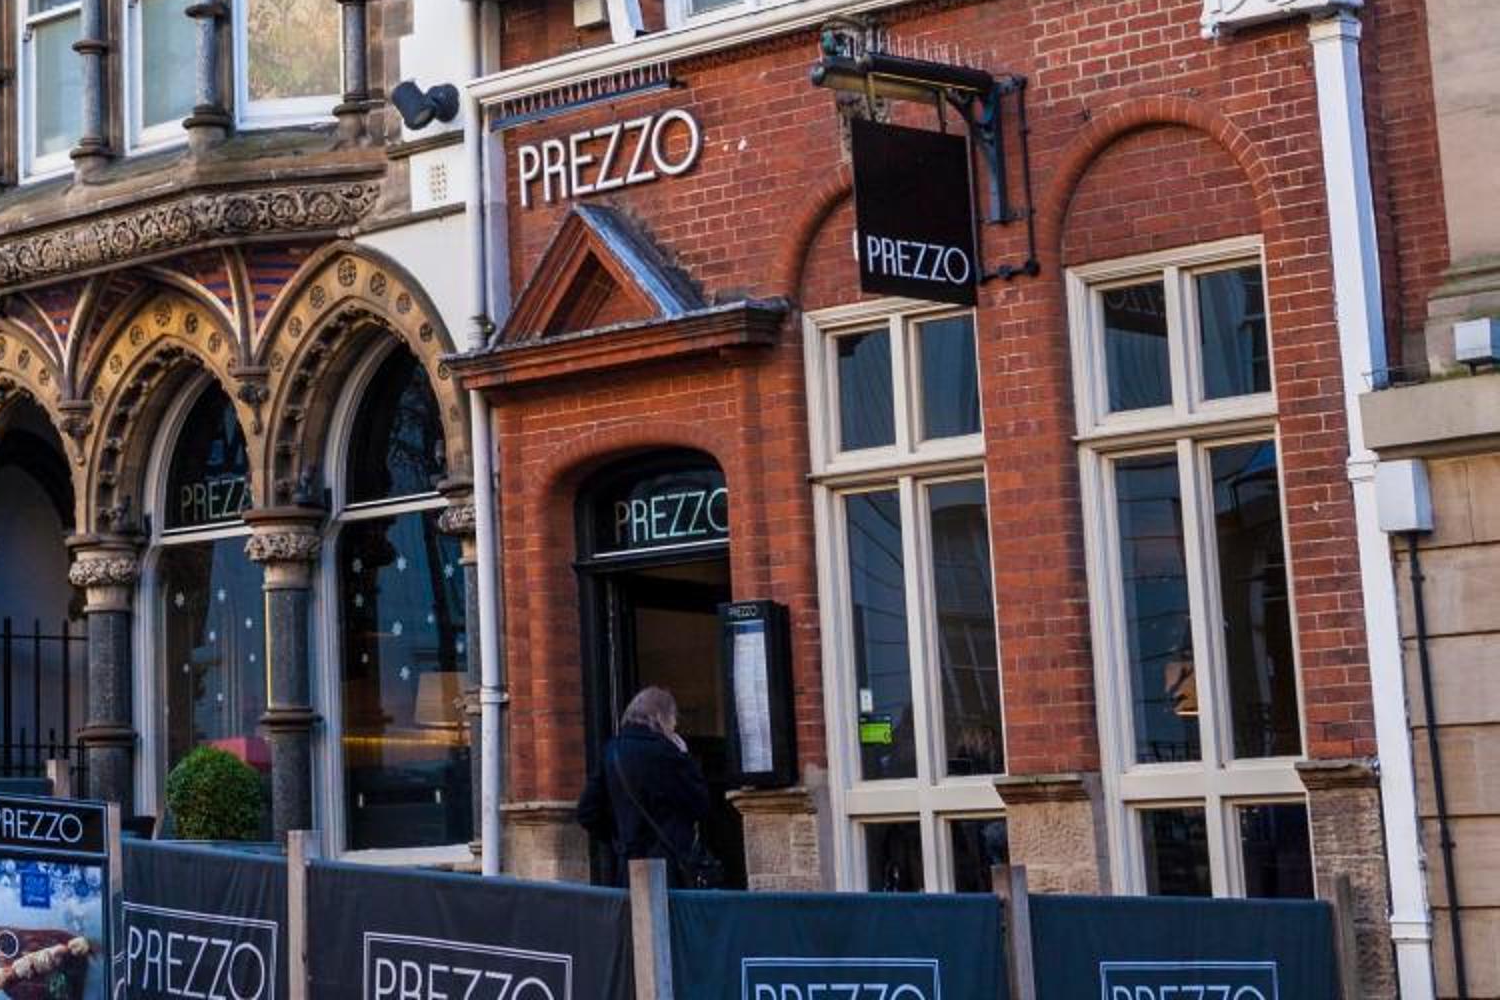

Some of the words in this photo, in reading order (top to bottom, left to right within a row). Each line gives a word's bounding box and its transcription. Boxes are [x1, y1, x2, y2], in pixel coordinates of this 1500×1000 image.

[517, 109, 699, 207] PREZZO
[866, 235, 970, 284] PREZZO
[180, 476, 250, 521] PREZZ
[614, 487, 729, 543] PREZZO
[127, 925, 266, 1000] PREZZO
